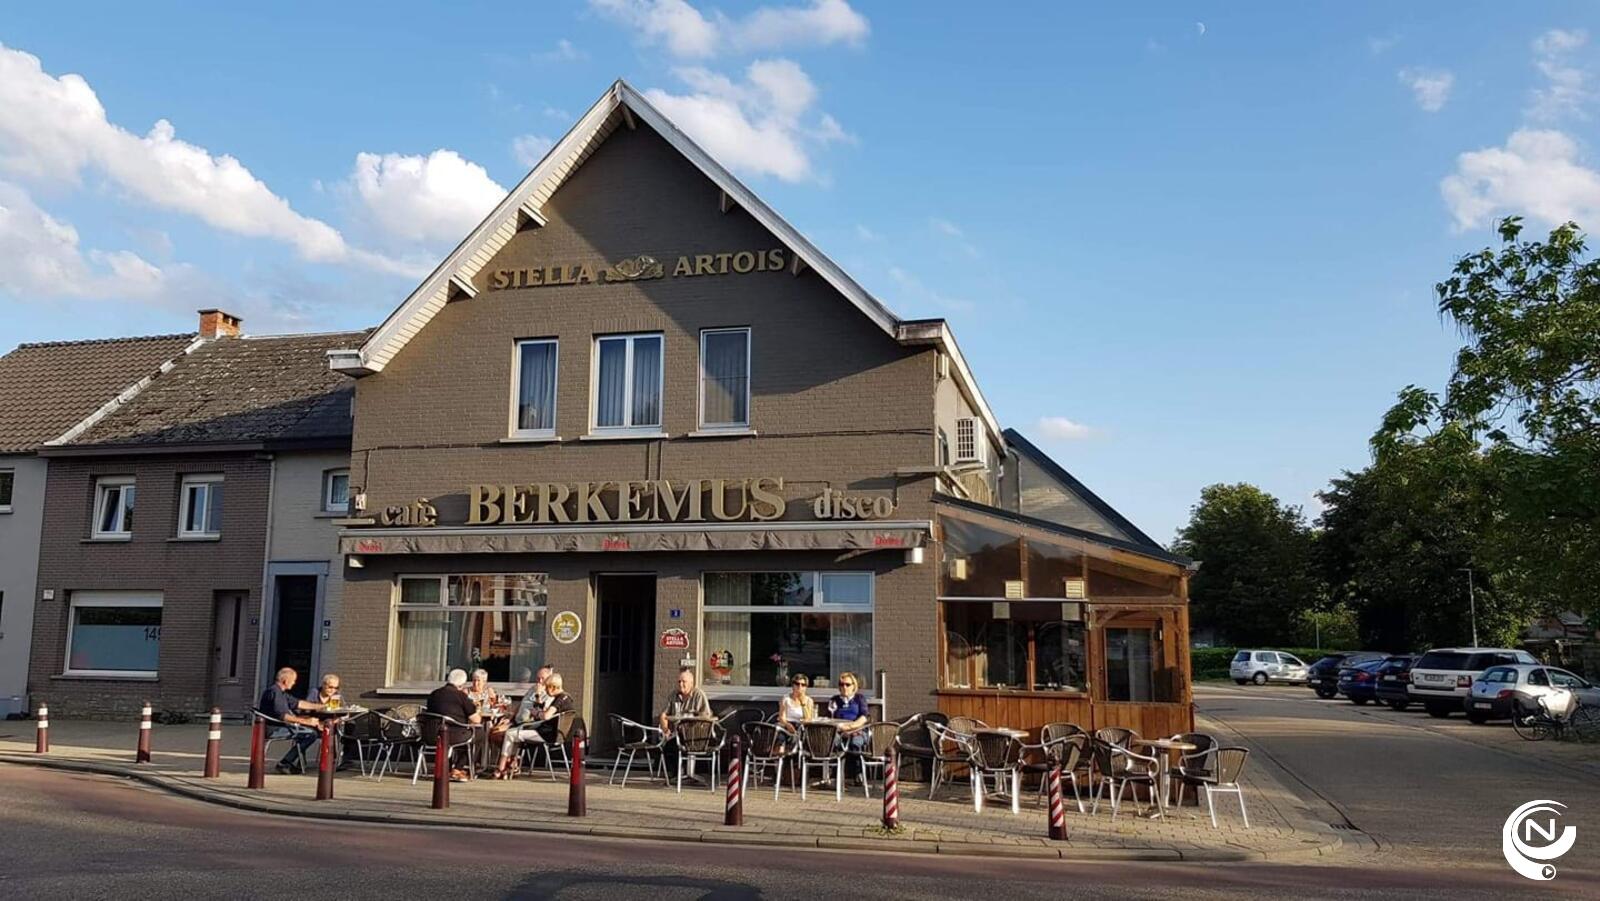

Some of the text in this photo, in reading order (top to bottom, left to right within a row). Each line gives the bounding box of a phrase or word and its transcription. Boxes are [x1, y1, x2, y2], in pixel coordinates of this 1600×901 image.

[493, 249, 785, 289] STELLA ARTOIS
[465, 477, 787, 525] BERKEMUS
[814, 488, 892, 519] disco
